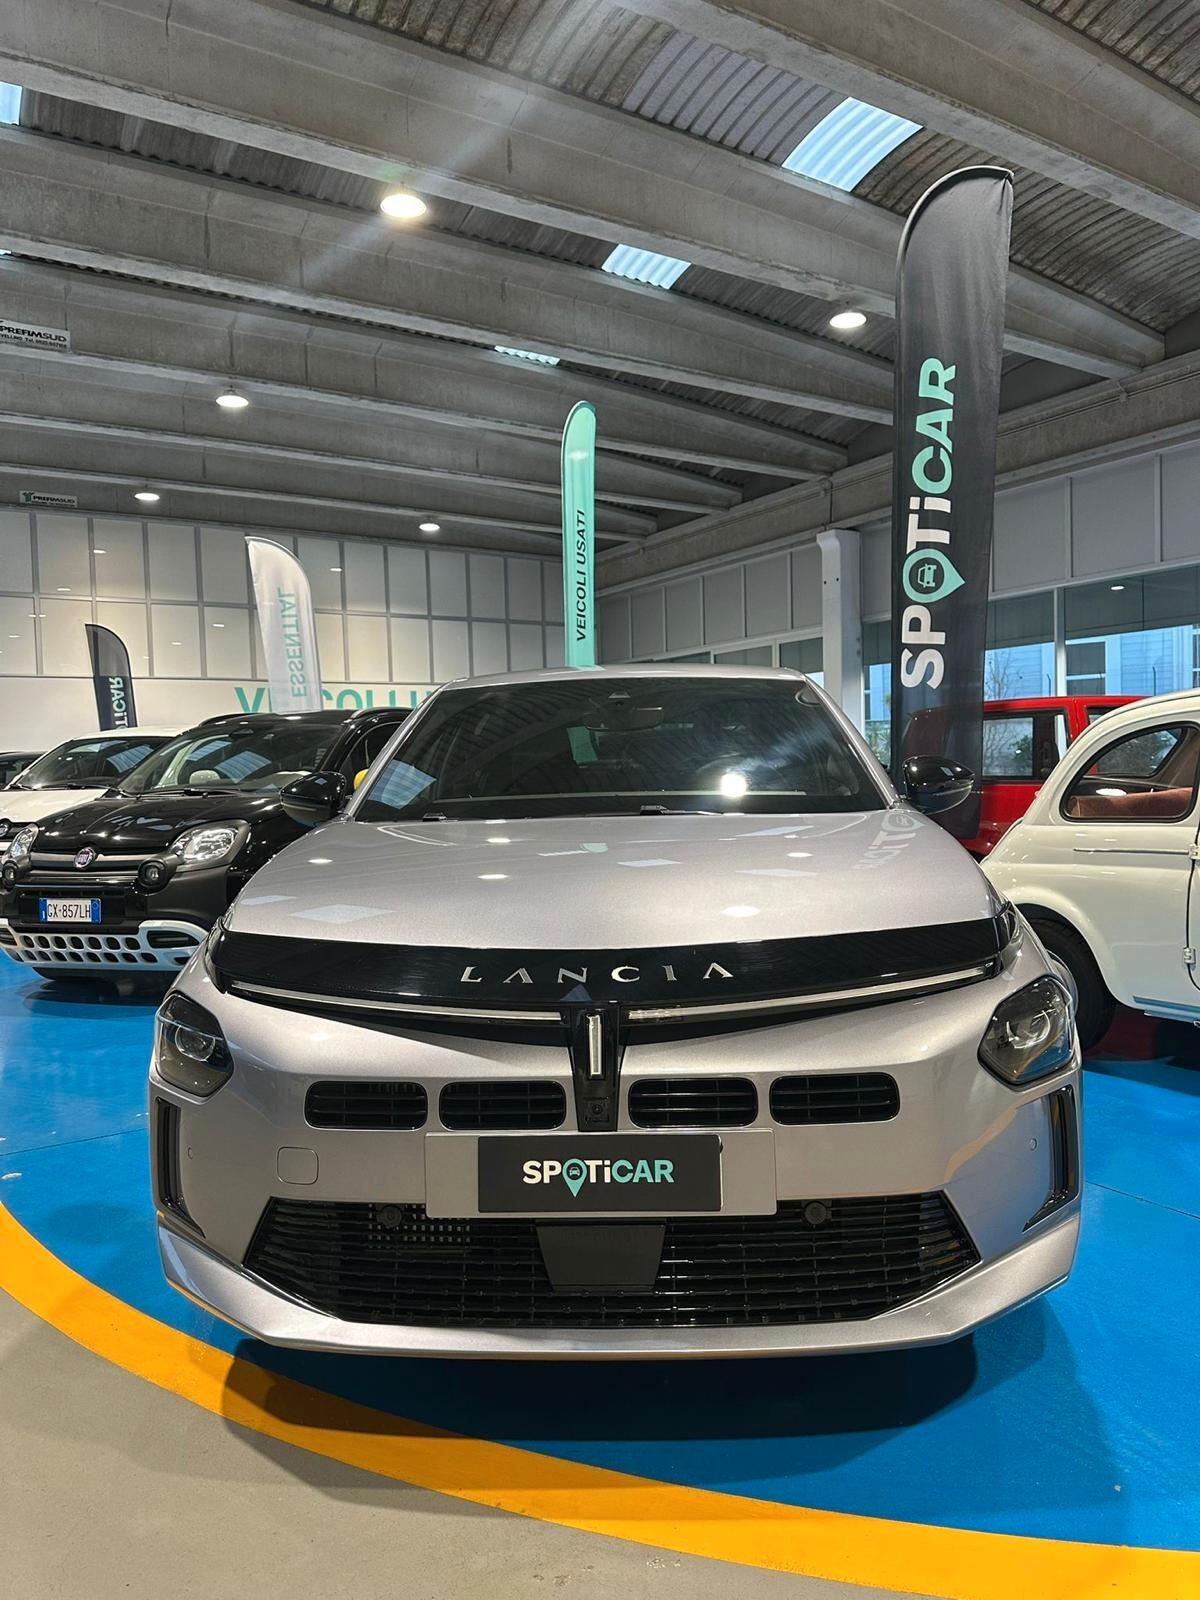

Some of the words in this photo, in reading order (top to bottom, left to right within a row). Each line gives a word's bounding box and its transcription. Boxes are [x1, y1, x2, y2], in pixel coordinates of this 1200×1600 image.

[576, 510, 587, 566] USATI
[576, 570, 587, 642] VEICOLI
[460, 962, 734, 984] LANCIA
